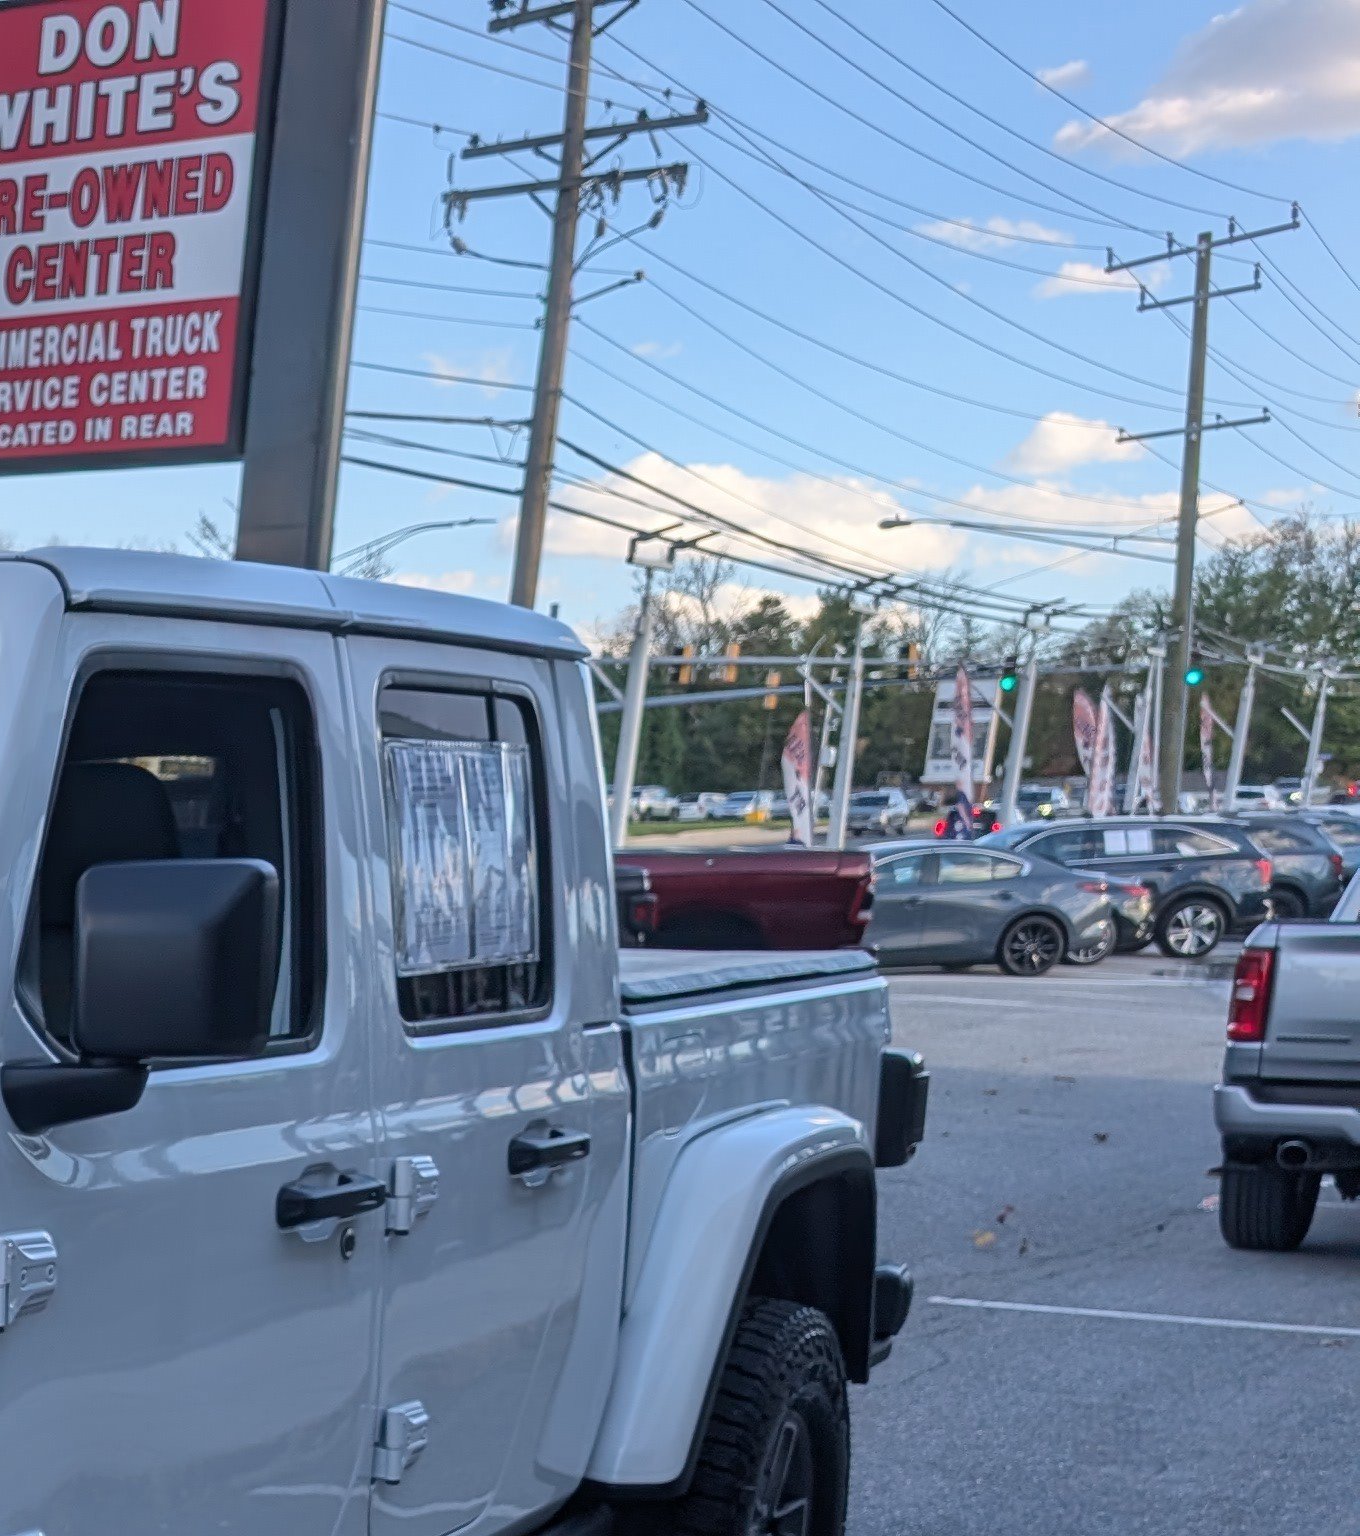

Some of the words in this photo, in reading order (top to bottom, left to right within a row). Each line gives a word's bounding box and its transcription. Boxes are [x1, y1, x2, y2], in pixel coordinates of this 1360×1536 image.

[37, 1, 180, 76] DON
[4, 231, 177, 304] CENTER
[130, 310, 222, 359] TRUCK
[88, 365, 208, 407] CENTER
[84, 417, 112, 443] IN
[120, 412, 194, 440] REAR
